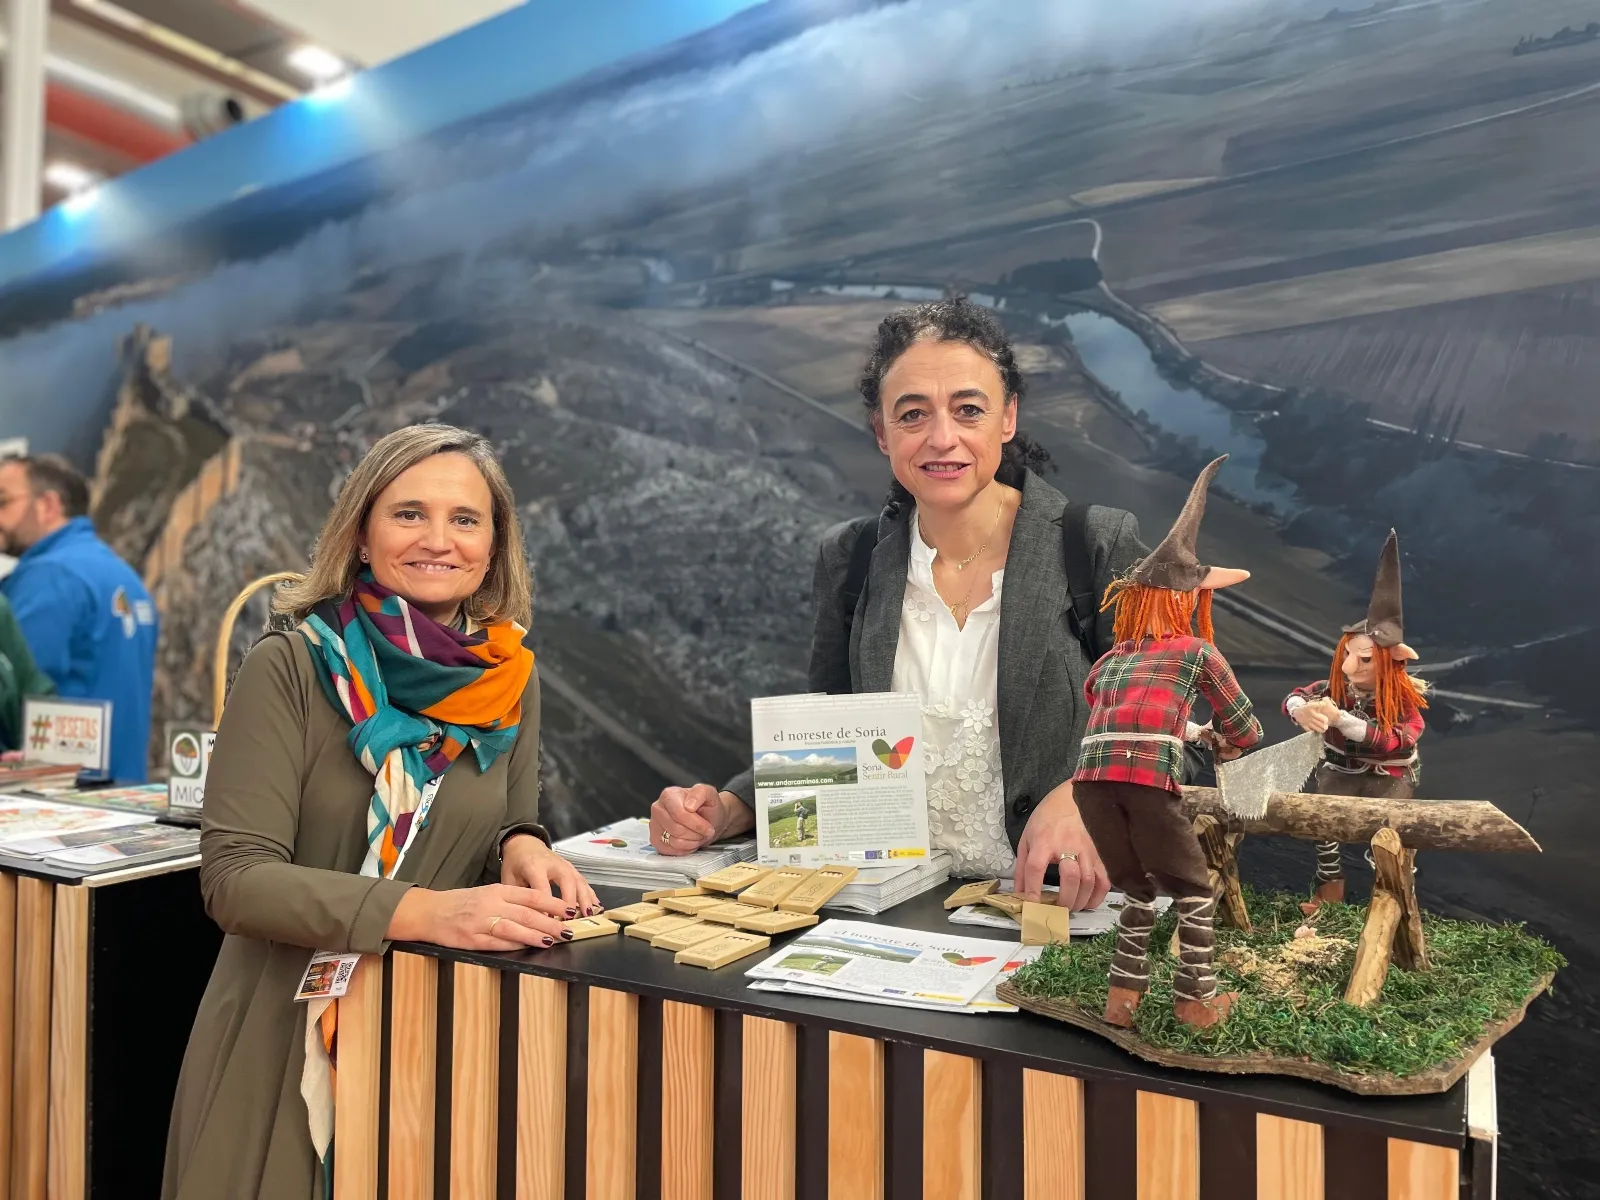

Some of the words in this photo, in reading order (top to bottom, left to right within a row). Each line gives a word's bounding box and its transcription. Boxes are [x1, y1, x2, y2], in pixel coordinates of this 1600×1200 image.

[773, 730, 784, 742] el
[788, 730, 833, 741] noreste
[836, 727, 851, 739] de
[855, 726, 887, 738] Soria
[862, 763, 882, 772] Soria
[887, 770, 908, 779] Rural
[757, 777, 834, 787] www.andarcaminos.com
